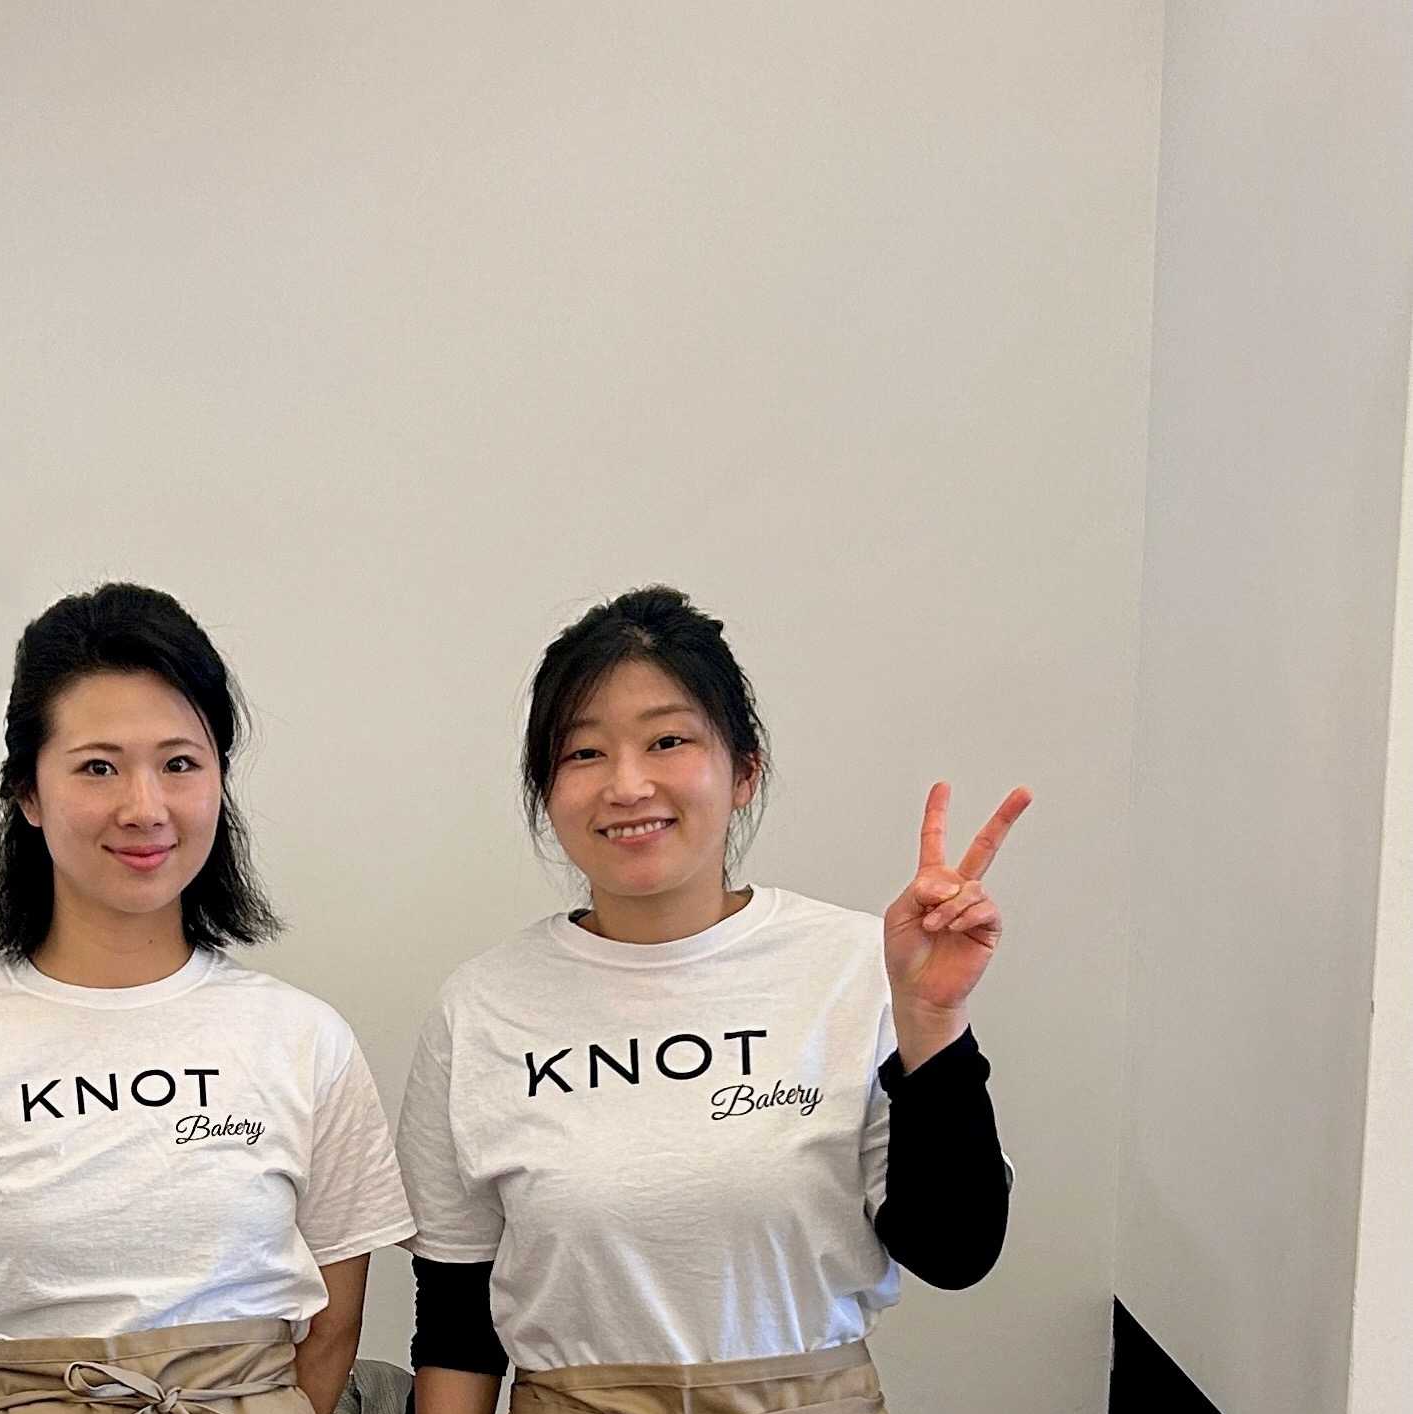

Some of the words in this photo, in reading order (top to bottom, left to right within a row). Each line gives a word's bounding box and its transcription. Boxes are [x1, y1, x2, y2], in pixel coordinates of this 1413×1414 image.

[525, 1029, 767, 1098] KNOT
[21, 1068, 220, 1122] KNOT
[710, 1079, 824, 1121] Bakery
[175, 1114, 266, 1146] Bakery
